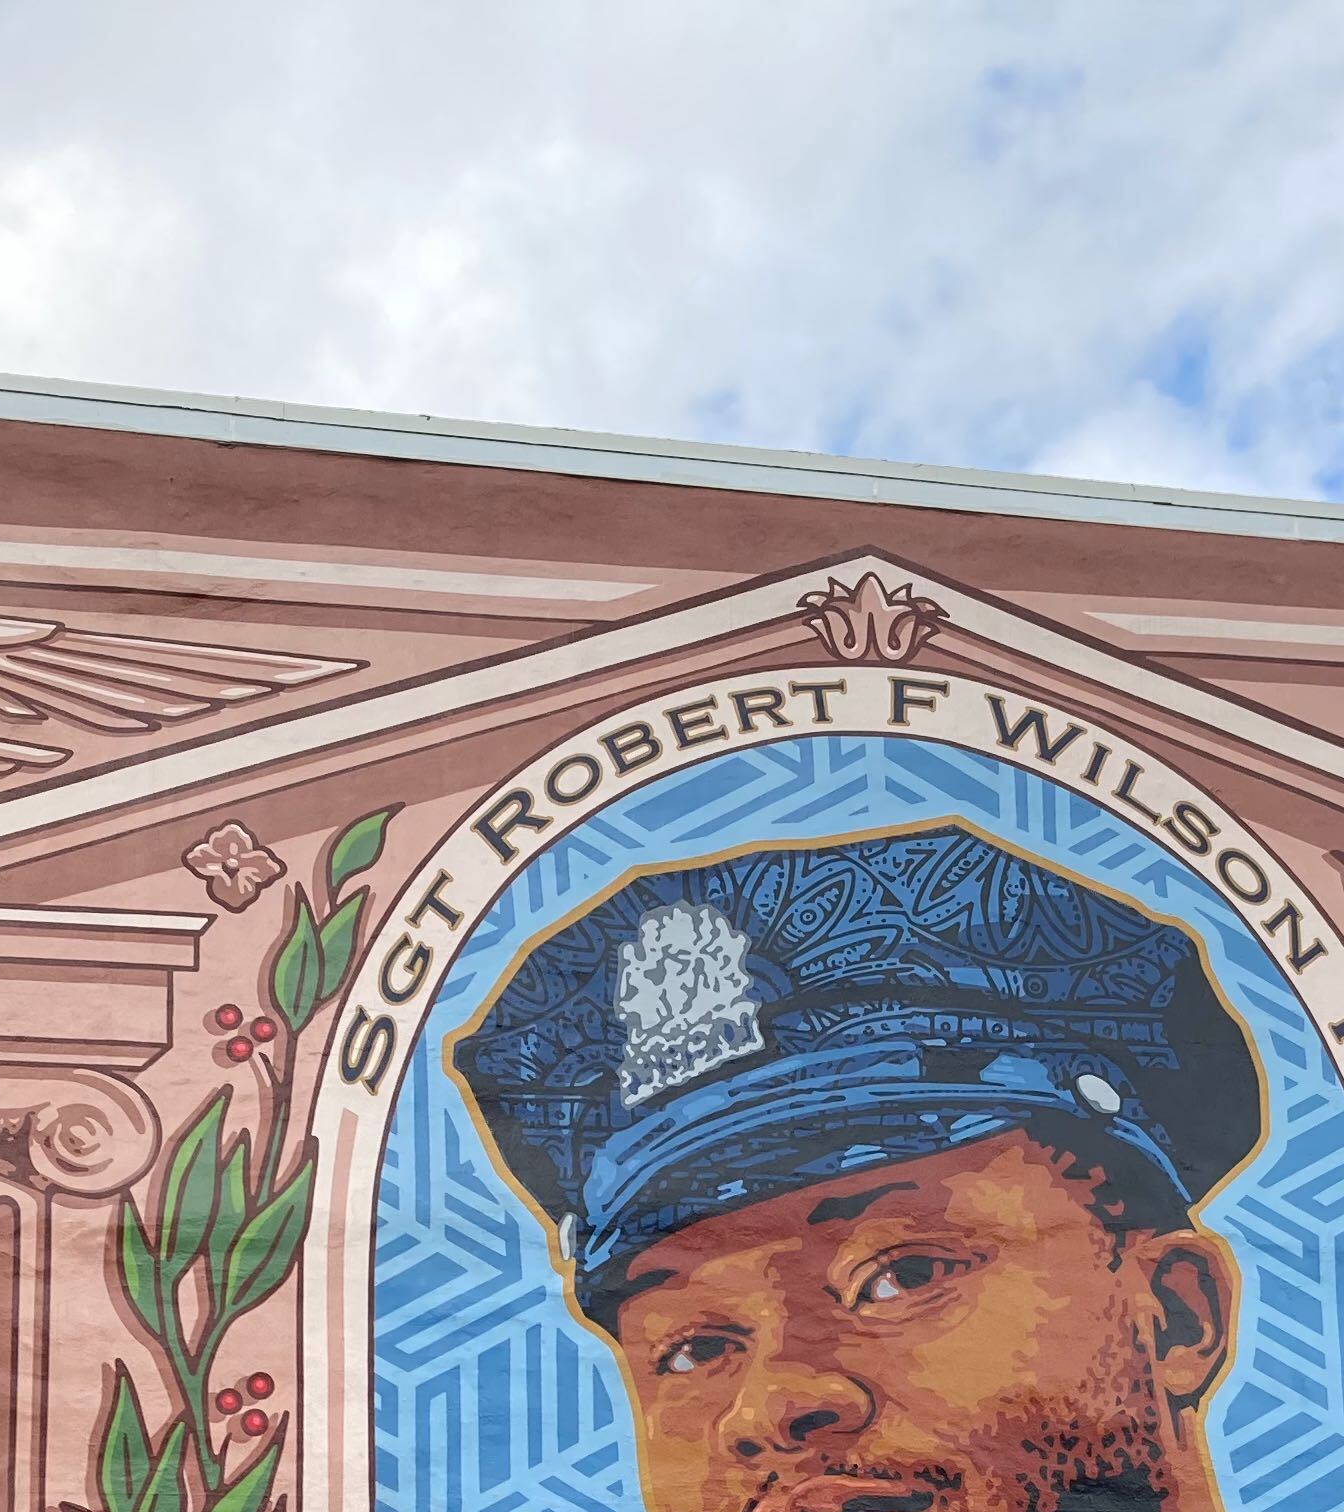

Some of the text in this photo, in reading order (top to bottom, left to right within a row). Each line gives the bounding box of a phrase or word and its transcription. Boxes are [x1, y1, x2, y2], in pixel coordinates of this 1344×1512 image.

[338, 869, 464, 1096] SGT
[469, 677, 847, 866] ROBERT
[886, 675, 950, 726] F
[984, 693, 1328, 974] WILSON
